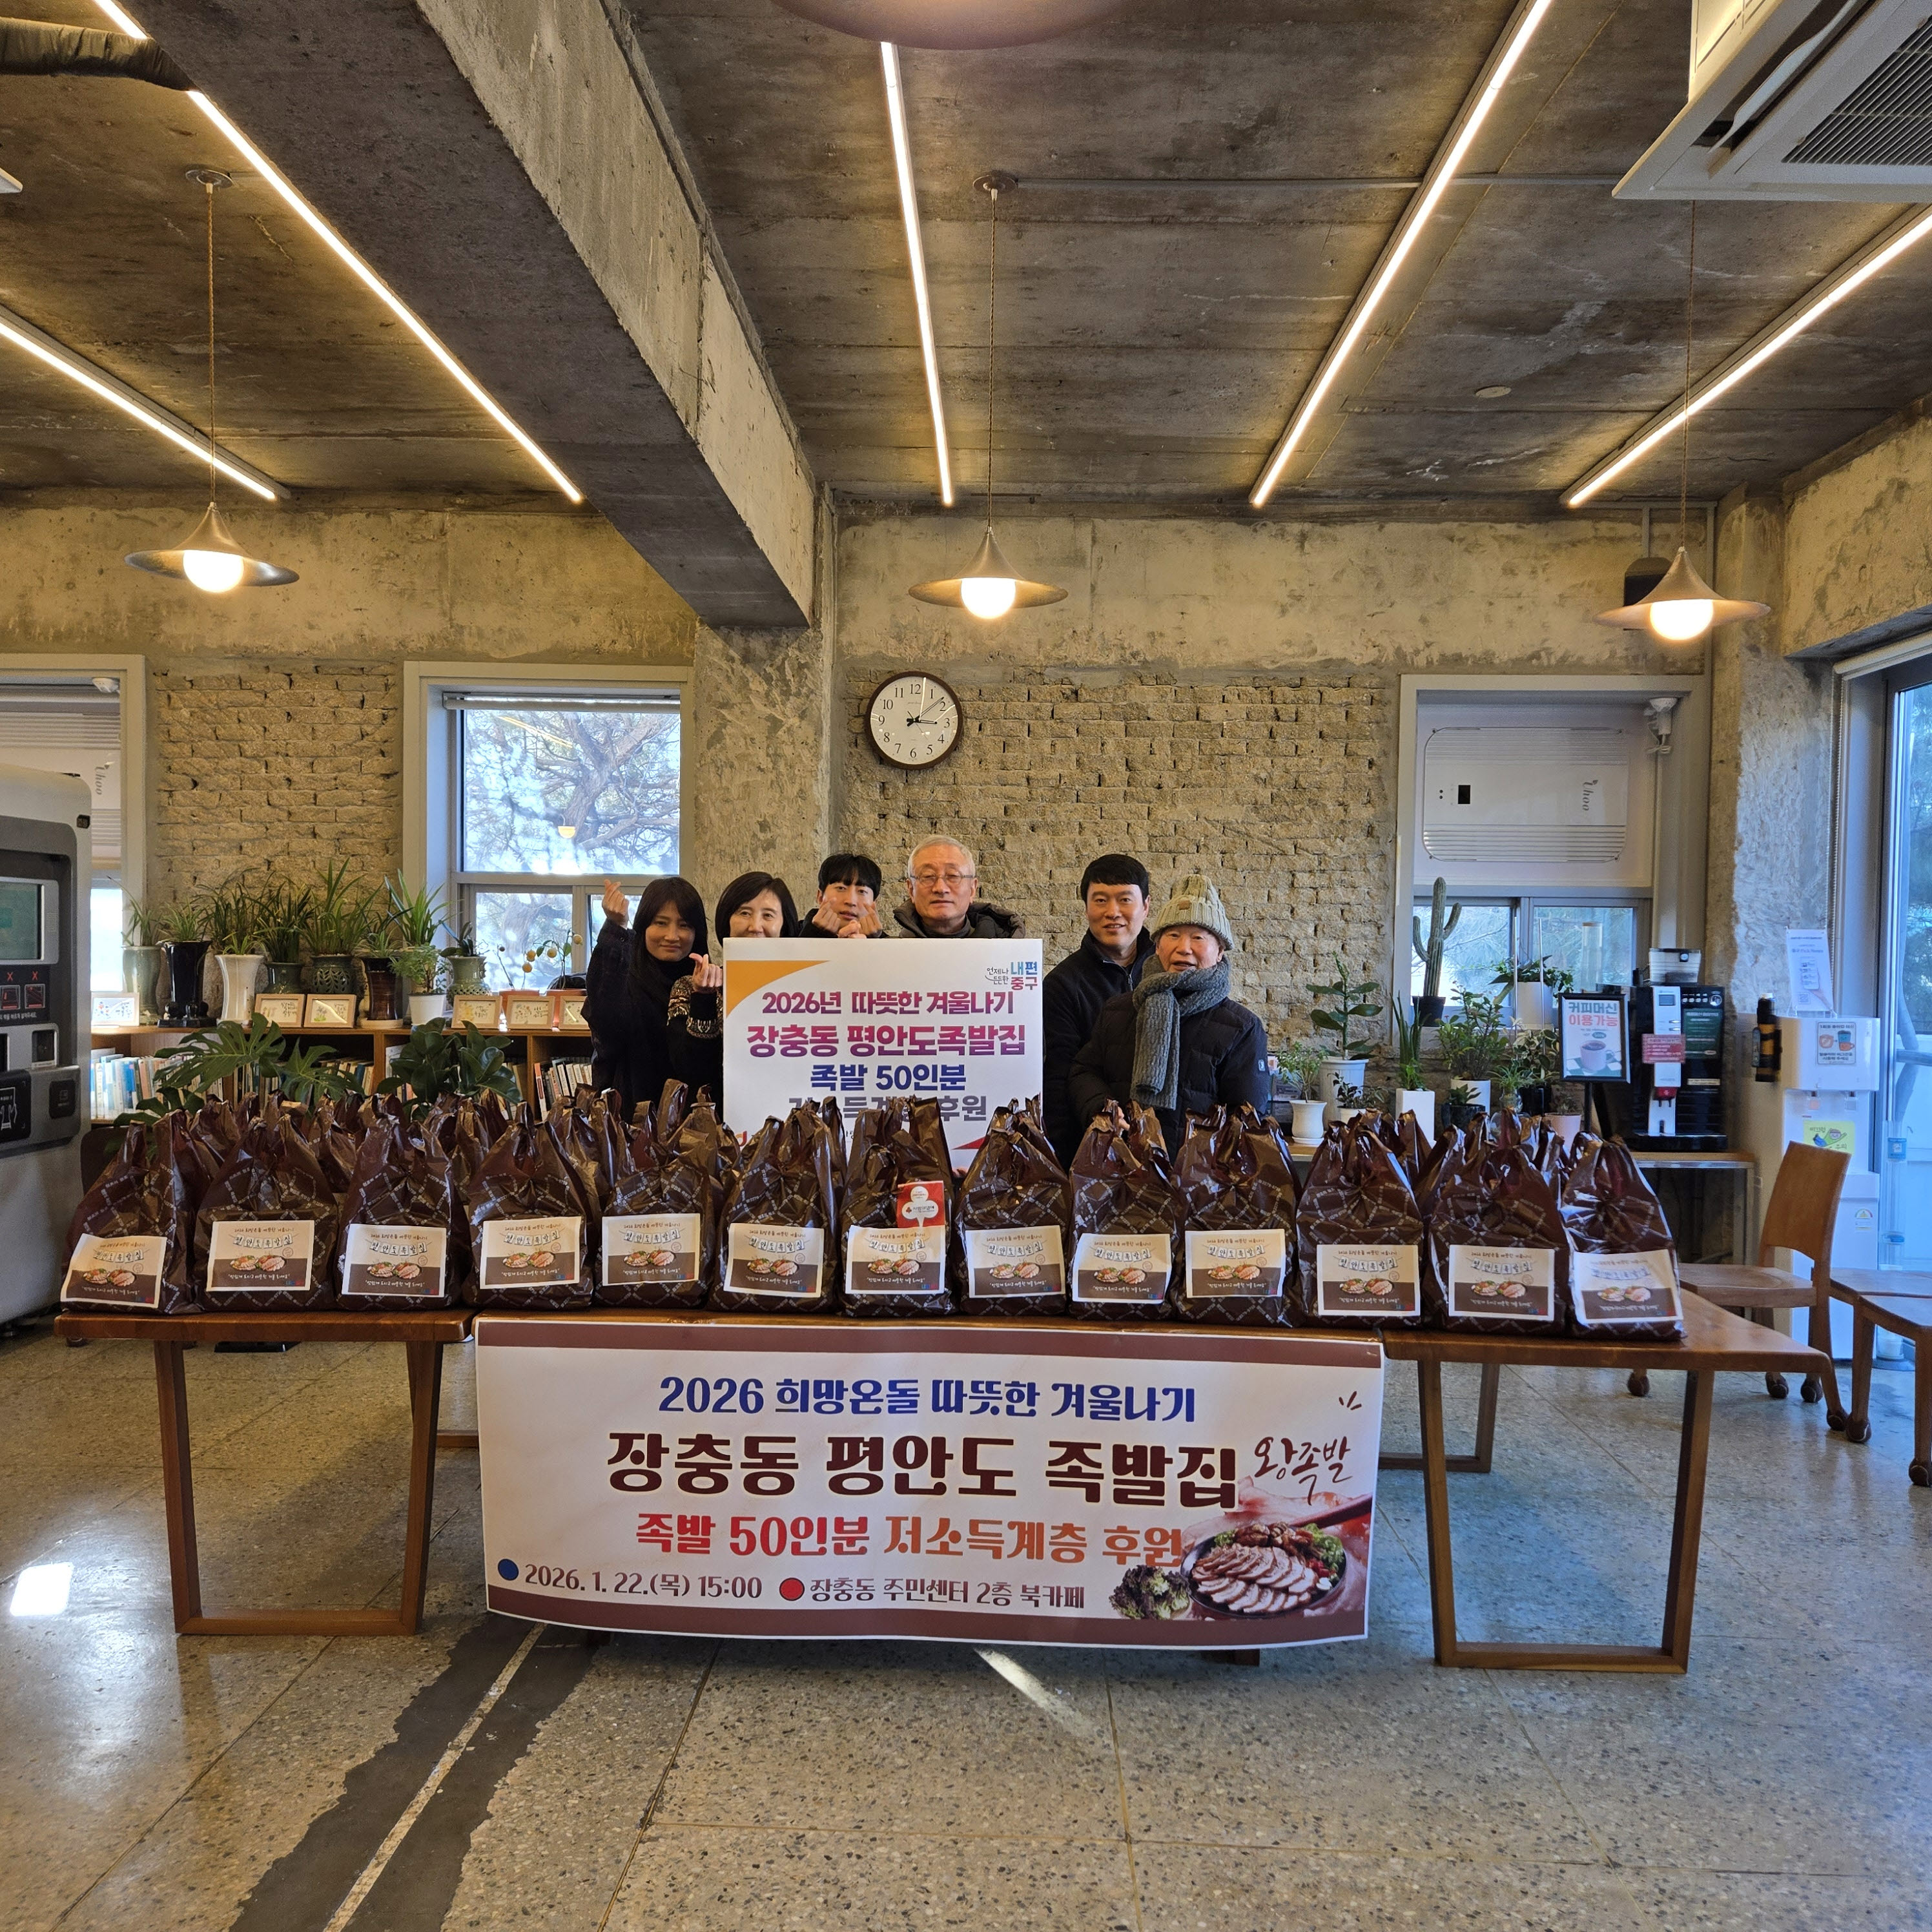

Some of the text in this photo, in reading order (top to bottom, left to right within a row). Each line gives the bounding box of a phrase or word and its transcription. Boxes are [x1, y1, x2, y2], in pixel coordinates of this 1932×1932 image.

[895, 688, 903, 698] 11
[910, 684, 921, 694] 12
[930, 689, 933, 699] 1
[883, 699, 893, 710] 10
[940, 701, 946, 711] 2
[878, 715, 885, 726] 9
[943, 718, 950, 728] 3
[884, 732, 890, 743] 8
[938, 734, 945, 743] 4
[894, 743, 901, 754] 7
[910, 748, 917, 758] 6
[926, 745, 932, 755] 5
[987, 967, 1009, 975] 언제나
[1011, 961, 1037, 975] 내편
[994, 976, 1009, 985] 든든한
[1011, 977, 1038, 990] 중구
[762, 991, 1014, 1014] 2026년 따뜻한 겨울나기
[1568, 1002, 1617, 1014] 커피머신
[1569, 1014, 1618, 1026] 이용가능
[747, 1025, 1025, 1058] 장충동 평안도족발집
[810, 1064, 966, 1091] 족발 50인분
[939, 1095, 987, 1121] 후원
[659, 1376, 1196, 1423] 2026 희망온돌 따뜻한 겨울나기
[608, 1432, 1237, 1508] 장충동 평안도 족발집
[1253, 1435, 1354, 1506] 왕족발
[636, 1513, 1182, 1567] 족발 50인분 저소득계층 후원
[524, 1564, 762, 1599] 2026. 1. 22.(목) 15:00
[810, 1577, 1084, 1608] 장충동 주민센터 2층 북카페
